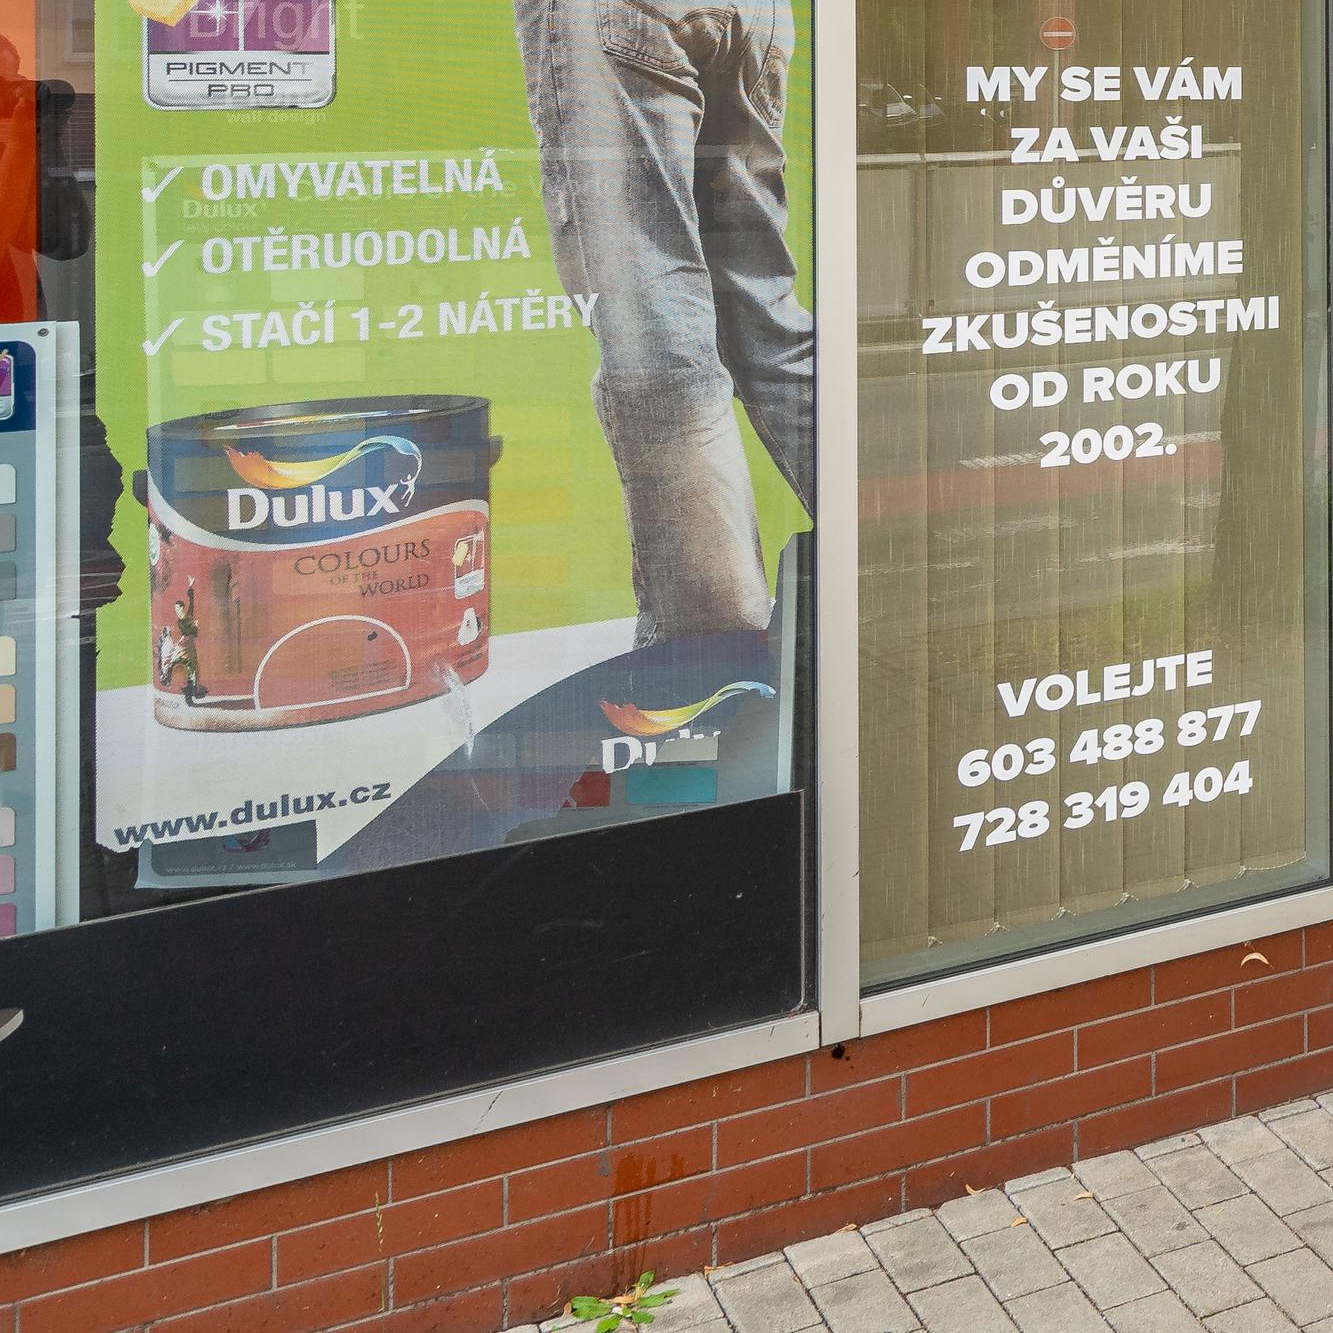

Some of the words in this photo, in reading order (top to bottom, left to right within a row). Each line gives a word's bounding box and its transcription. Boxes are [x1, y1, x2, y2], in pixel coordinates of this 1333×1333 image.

[166, 62, 310, 76] PIGMENT
[207, 84, 275, 98] PRO
[966, 66, 1048, 102] MY
[1060, 66, 1121, 101] SE
[1133, 57, 1242, 100] VÁM
[1011, 127, 1079, 163] ZA
[1090, 116, 1202, 161] VAŠI
[201, 149, 504, 200] OMYVATELNÁ
[1001, 176, 1212, 225] DŮVĚRU
[202, 217, 531, 276] OTĚRUODOLNÁ
[965, 234, 1244, 289] ODMĚNÍME
[201, 300, 336, 352] STAČÍ
[351, 304, 424, 341] 1-2
[438, 288, 600, 337] NÁTĚRY
[922, 296, 1280, 354] ZKUŠENOSTMI
[990, 372, 1068, 410] OD
[1083, 358, 1221, 403] ROKU
[1039, 422, 1177, 468] 2002.
[227, 483, 400, 530] Dulux
[294, 539, 431, 576] COLOURS
[330, 574, 349, 585] OF
[353, 570, 379, 583] THE
[360, 573, 429, 598] WORLD
[997, 649, 1213, 717] VOLEJTE
[957, 737, 1056, 788] 603
[1070, 723, 1164, 765] 488
[1176, 699, 1262, 747] 877
[114, 782, 391, 845] www.dulux.cz
[953, 800, 1050, 852] 728
[1063, 780, 1151, 829] 319
[1162, 759, 1253, 807] 404
